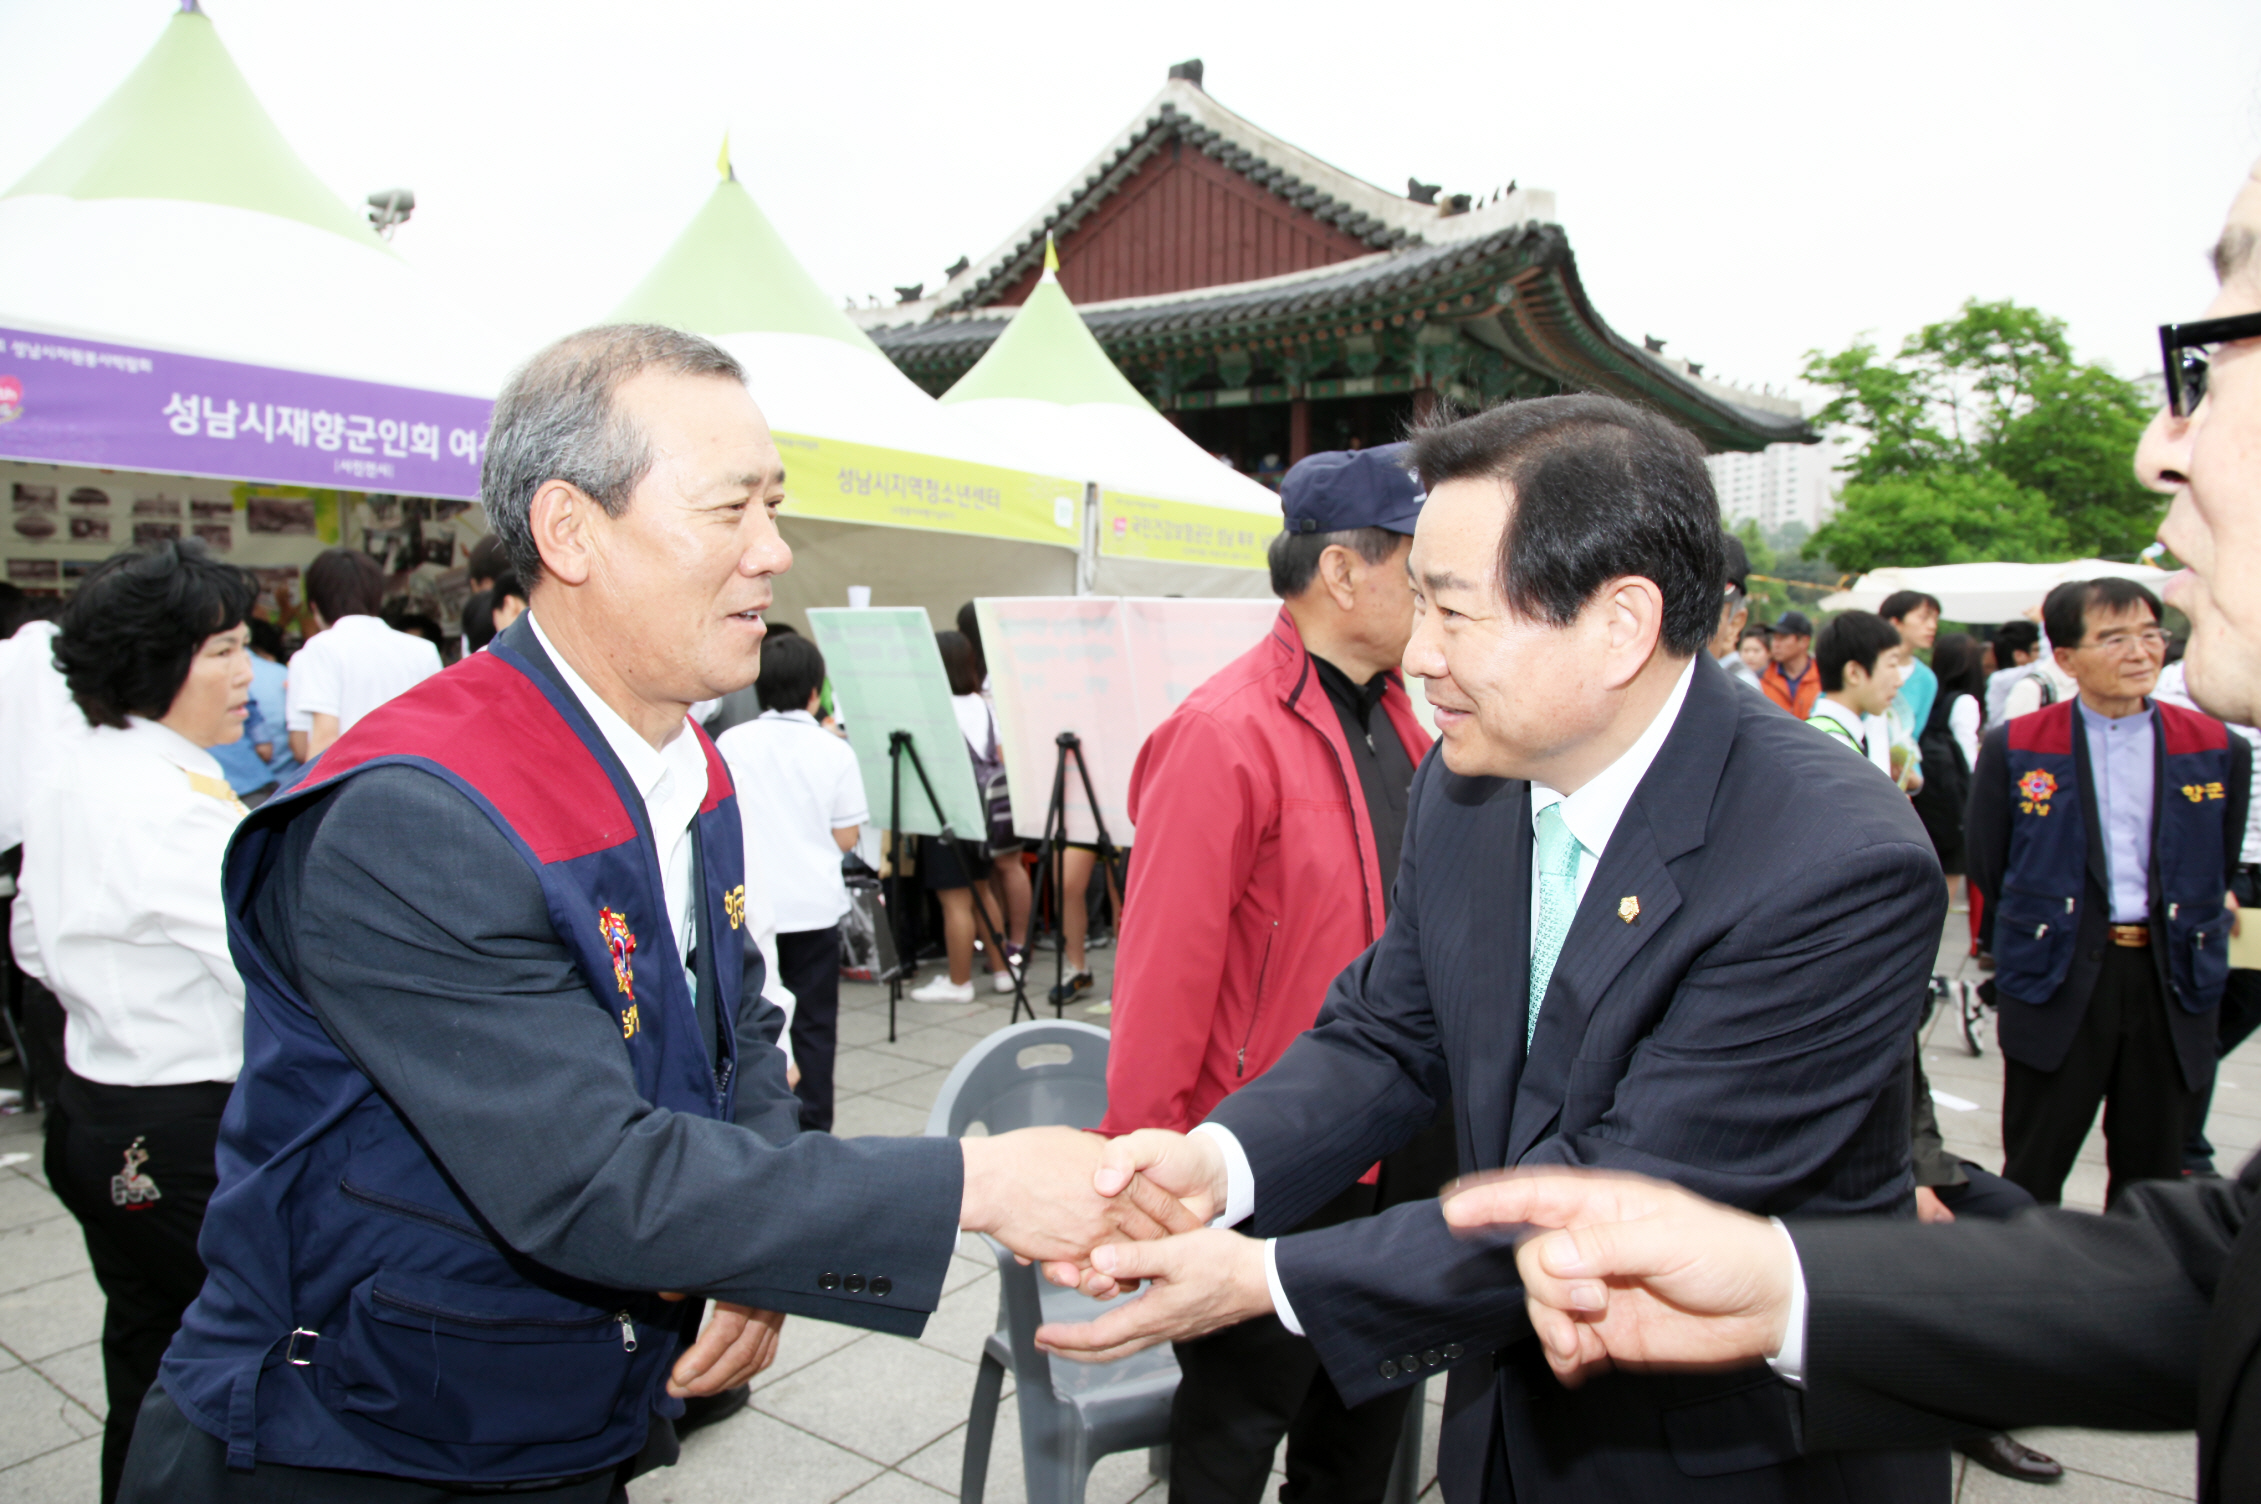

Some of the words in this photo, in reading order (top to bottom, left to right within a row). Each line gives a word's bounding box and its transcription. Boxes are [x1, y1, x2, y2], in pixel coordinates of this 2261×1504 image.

[162, 391, 440, 462] 성남시재향군인회
[449, 426, 488, 466] 여
[836, 466, 1001, 511] 성남시지역청소년센터
[2181, 781, 2226, 803] 향군
